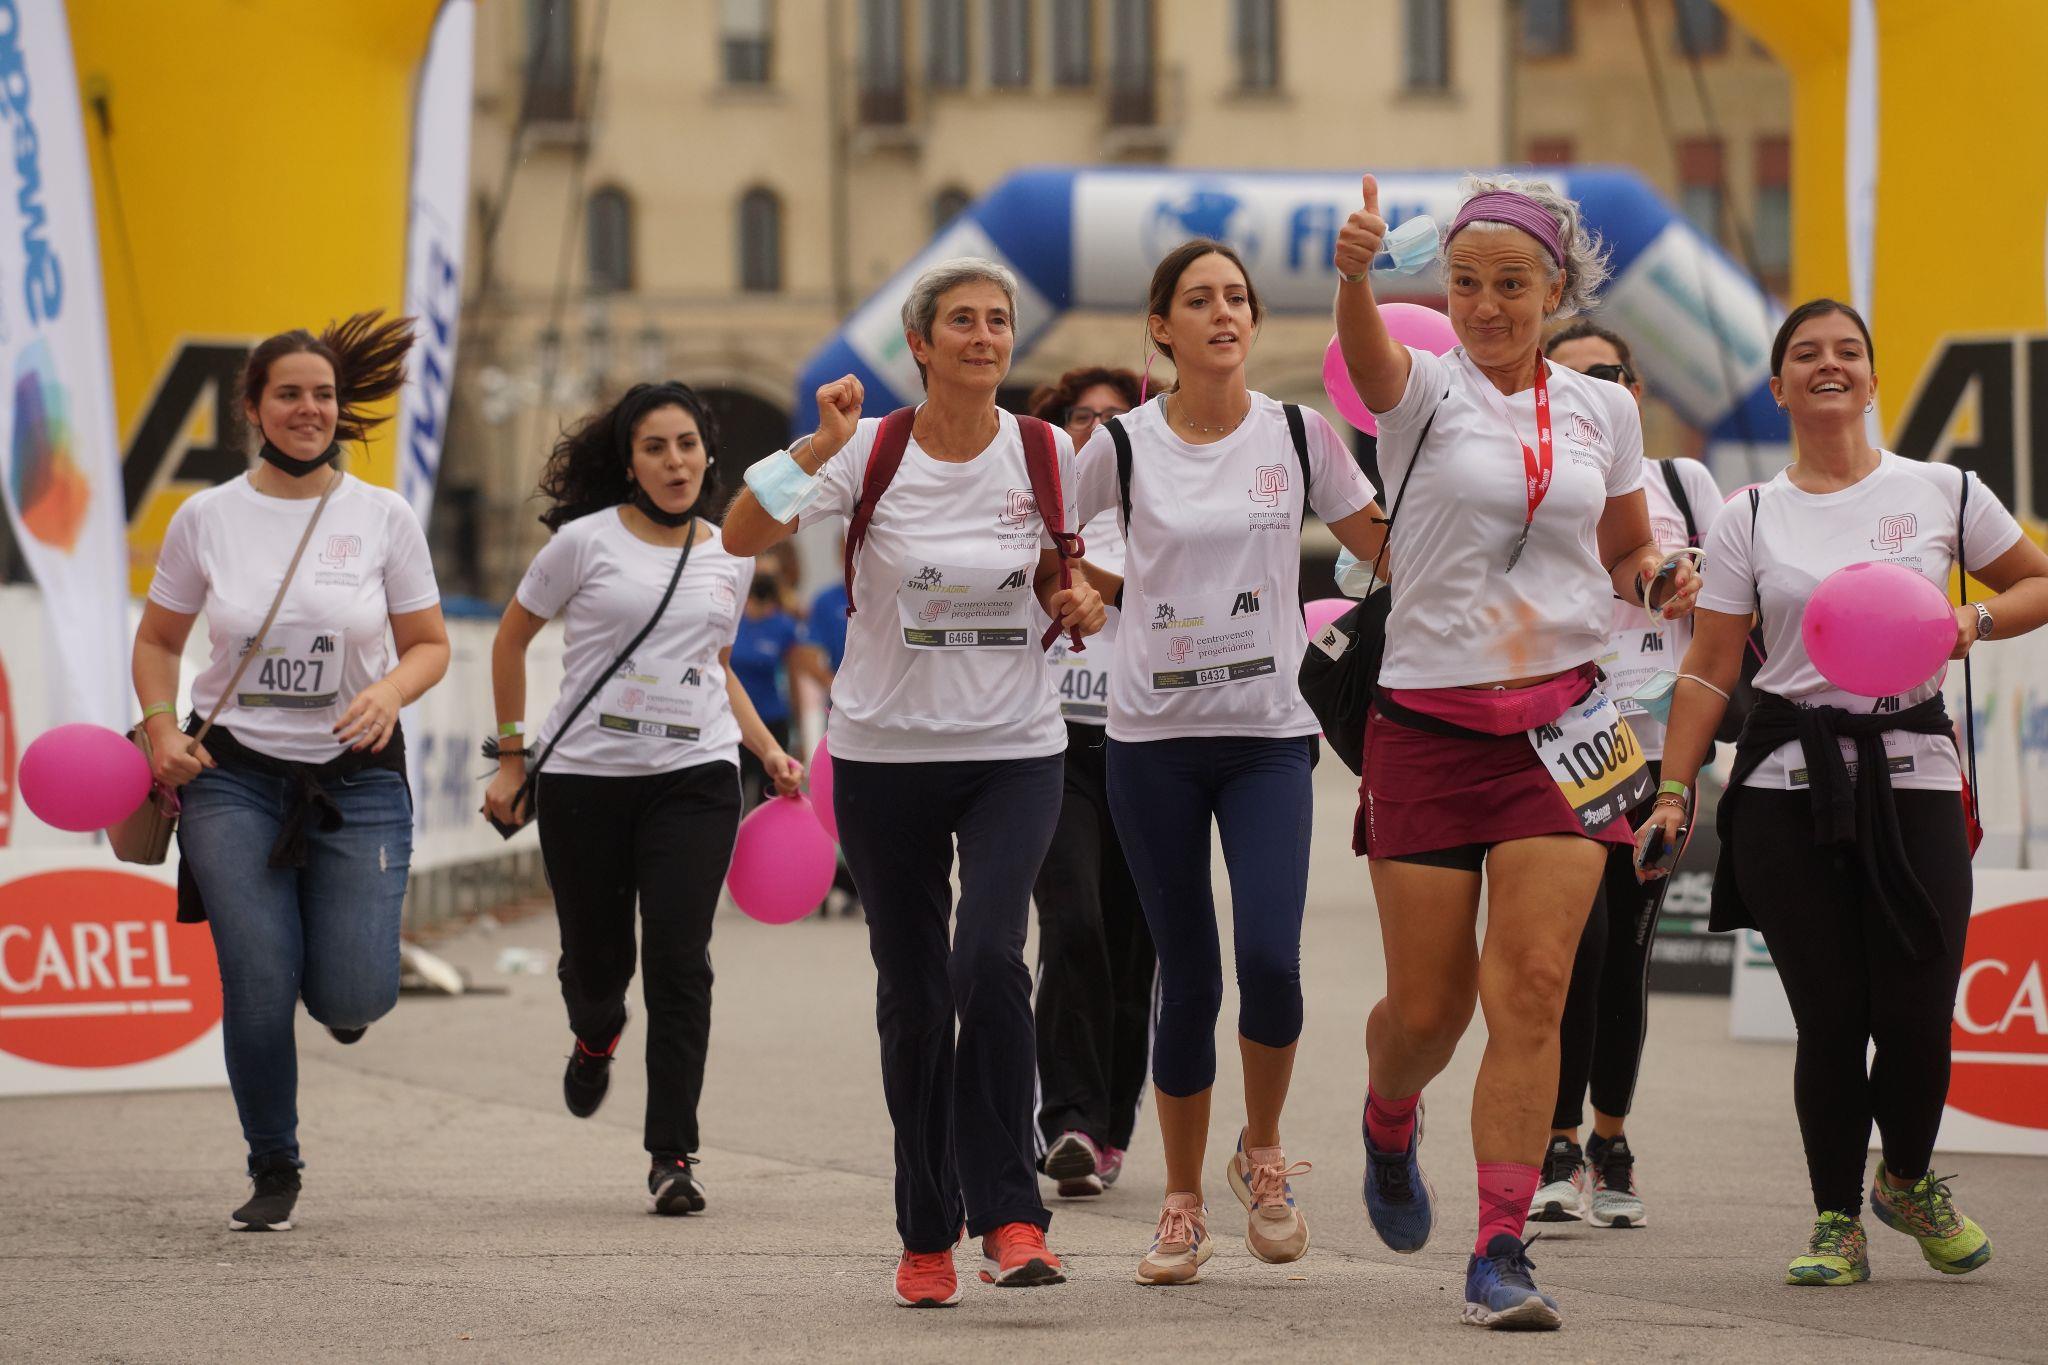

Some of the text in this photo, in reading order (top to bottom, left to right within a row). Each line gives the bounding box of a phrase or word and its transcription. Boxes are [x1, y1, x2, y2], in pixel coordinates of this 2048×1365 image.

[948, 632, 974, 643] 6466
[258, 658, 324, 692] 4027
[1200, 669, 1226, 682] 6432
[1620, 699, 1642, 711] 647
[1556, 715, 1635, 789] 10057
[0, 920, 190, 994] CAREL
